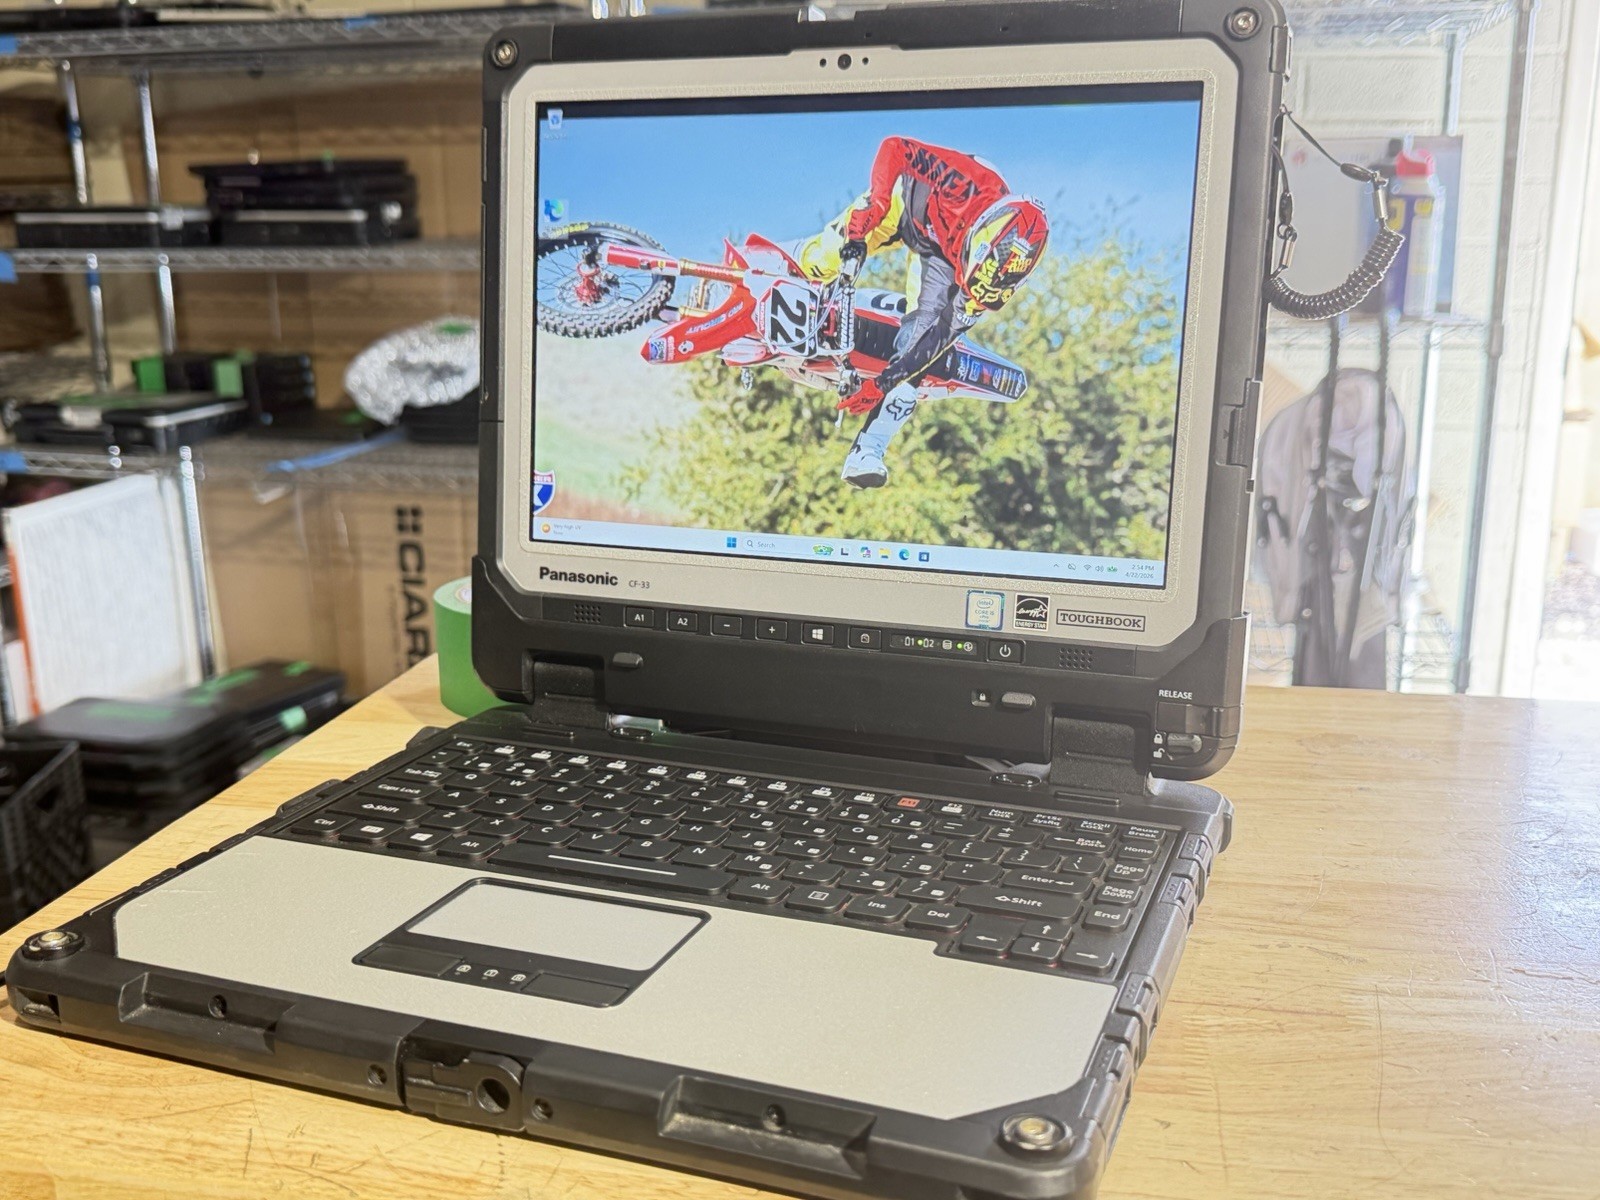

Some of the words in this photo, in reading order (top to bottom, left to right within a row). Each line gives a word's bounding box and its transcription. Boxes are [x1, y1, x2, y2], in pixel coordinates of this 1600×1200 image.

[771, 287, 808, 355] 22
[540, 566, 618, 586] Panasonic
[629, 579, 650, 589] CF-33
[634, 614, 645, 622] A1
[677, 618, 689, 626] A2
[1060, 612, 1142, 628] TOUGHBOOK
[1016, 620, 1033, 628] ENERGY
[1158, 689, 1193, 700] RELEASE
[378, 783, 399, 791] Caps
[374, 804, 400, 813] Shift
[991, 808, 1014, 816] Num
[314, 818, 336, 826] Ctrl
[1032, 818, 1060, 827] SysRq
[1082, 820, 1110, 828] Scroll
[1080, 823, 1104, 831] Lock
[1130, 826, 1160, 834] Pause
[1124, 846, 1154, 854] Home
[1116, 864, 1145, 873] Page
[1021, 874, 1056, 884] Enter
[751, 883, 771, 891] Alt
[1105, 886, 1135, 895] Page
[1102, 890, 1132, 899] Down
[868, 901, 887, 909] Ins
[1011, 897, 1043, 907] Shift
[927, 910, 950, 919] Del
[1094, 911, 1121, 920] End
